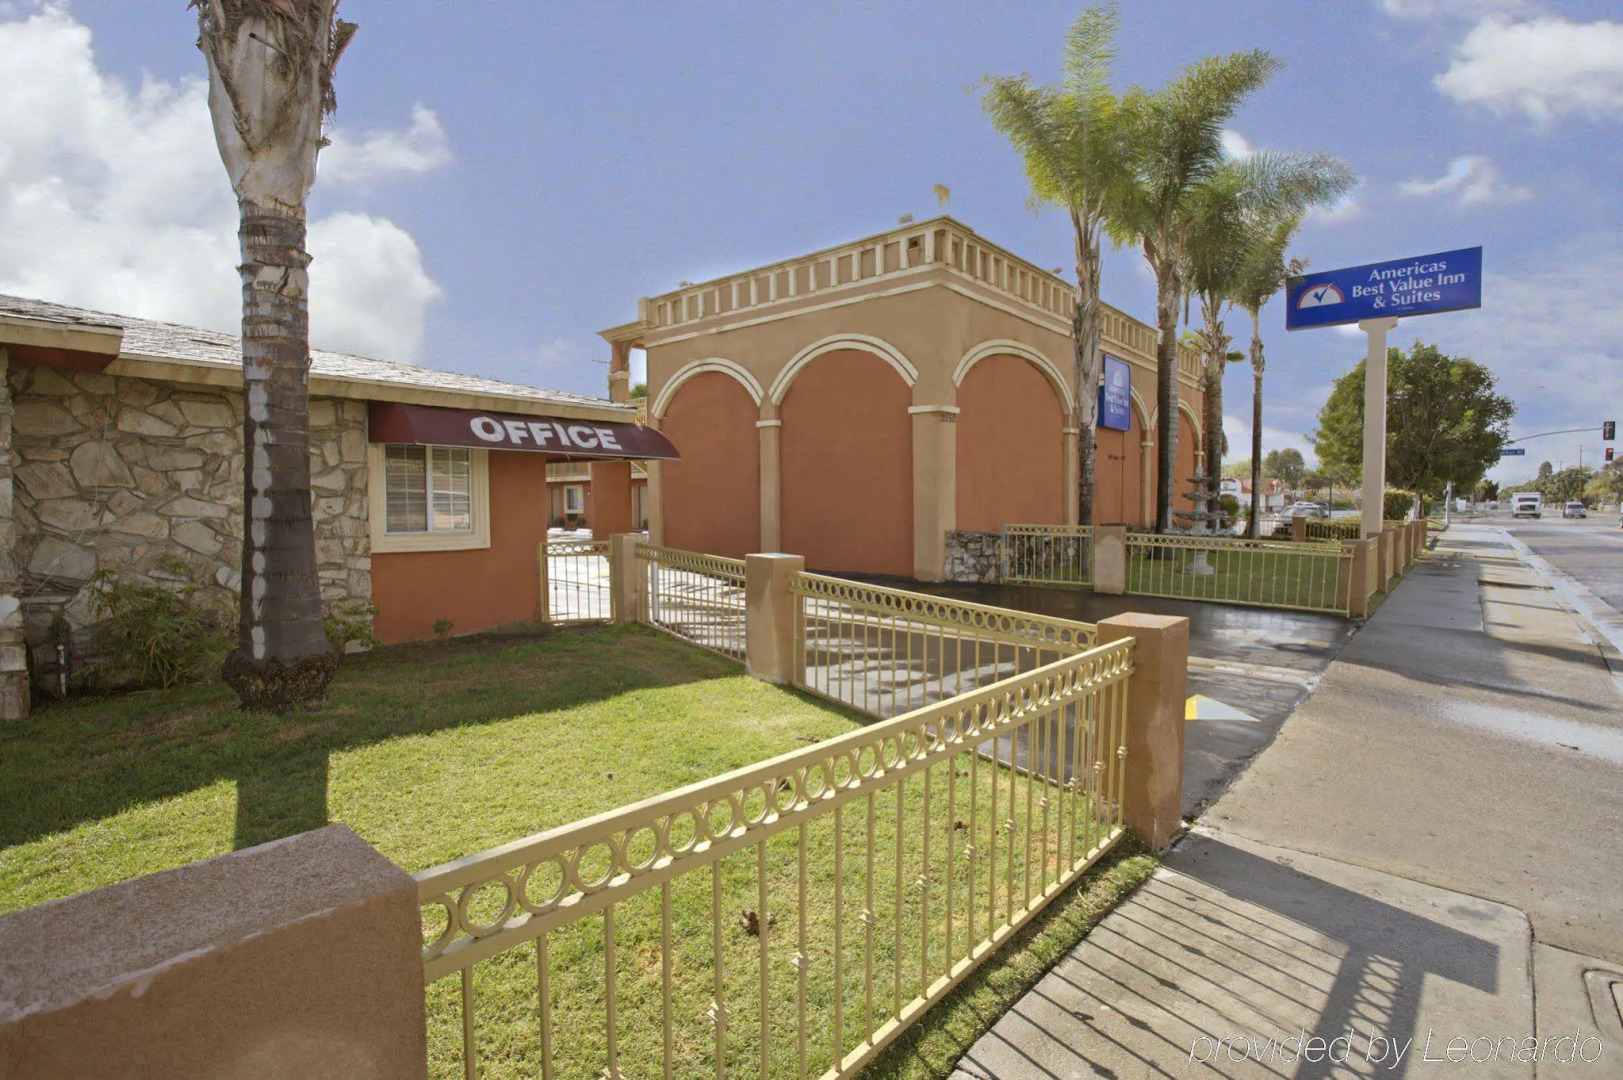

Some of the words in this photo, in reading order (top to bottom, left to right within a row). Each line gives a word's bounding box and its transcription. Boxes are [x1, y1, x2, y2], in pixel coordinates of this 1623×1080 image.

[1370, 261, 1447, 281] Americas
[1352, 282, 1385, 298] Best
[1390, 275, 1433, 293] Value
[1438, 272, 1466, 286] Inn
[1374, 296, 1387, 309] &
[1391, 290, 1441, 307] Suites
[470, 416, 623, 451] OFFICE
